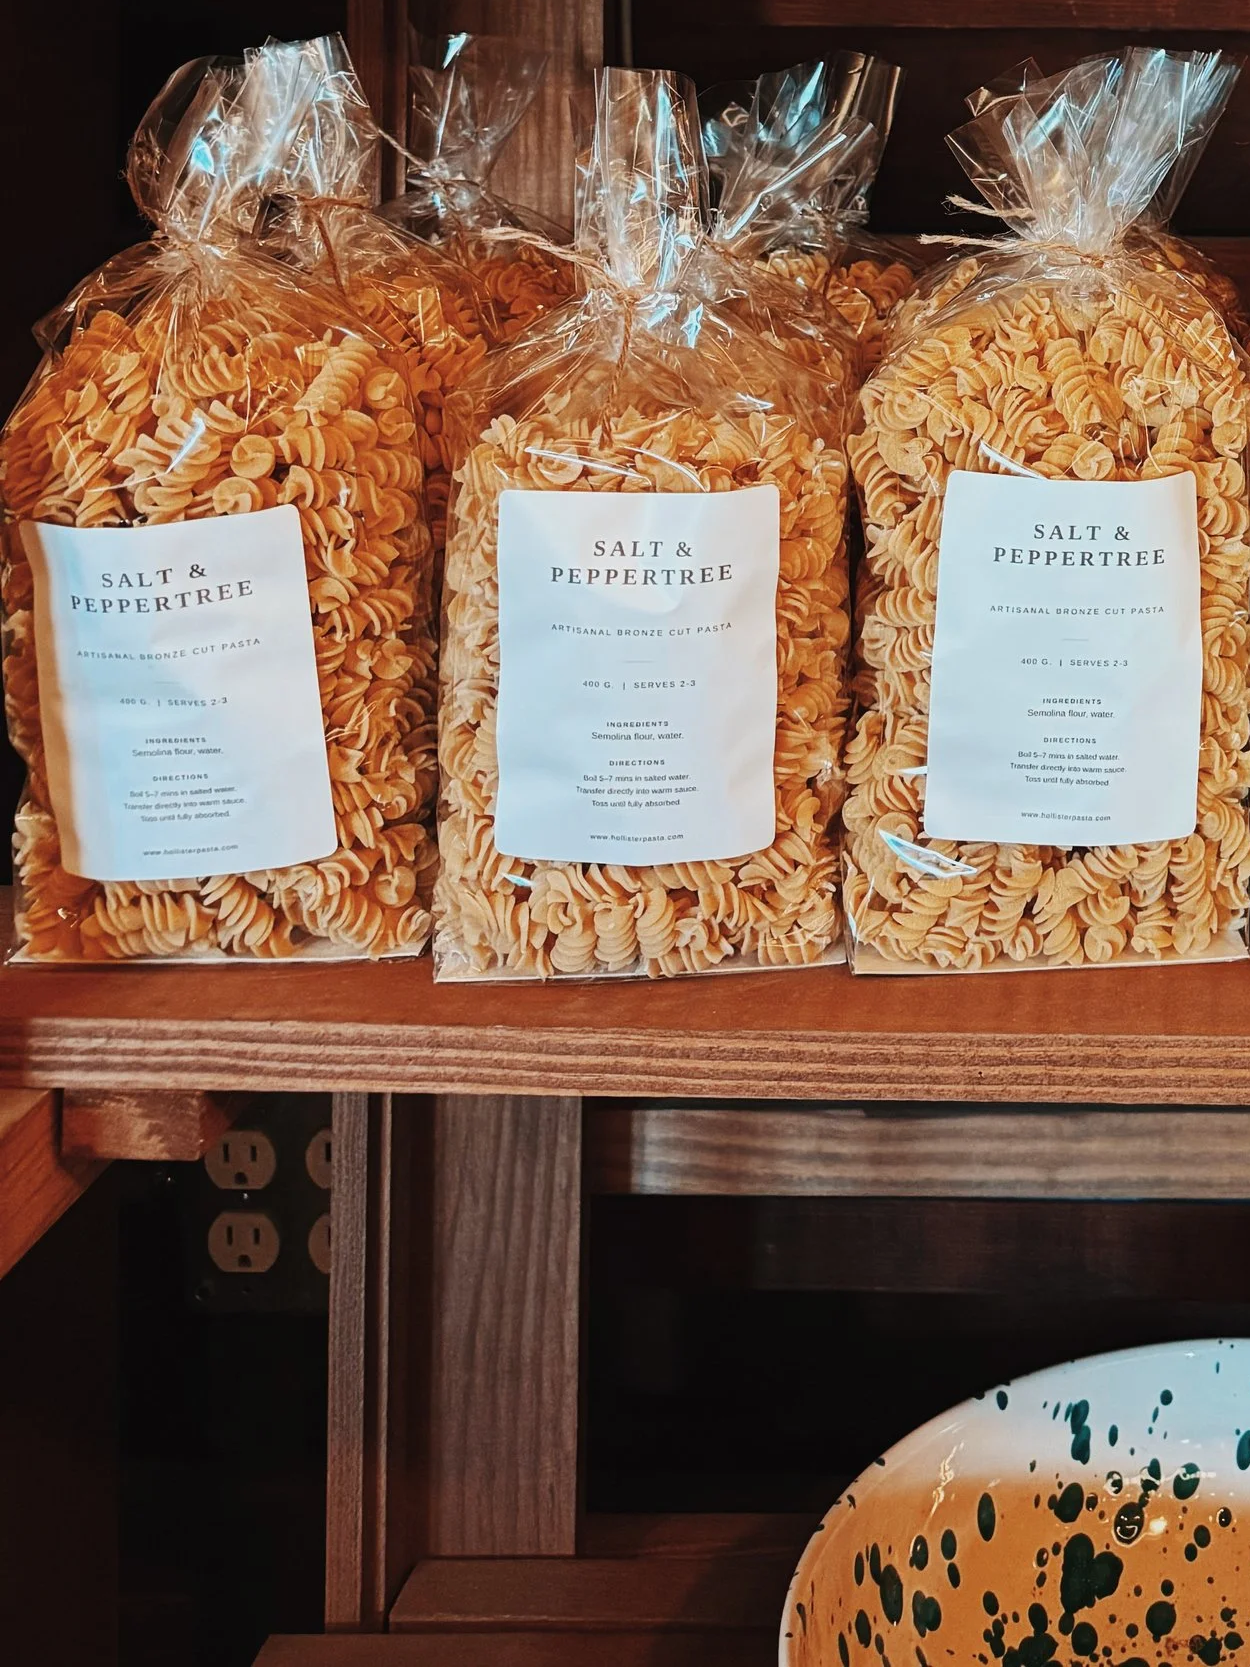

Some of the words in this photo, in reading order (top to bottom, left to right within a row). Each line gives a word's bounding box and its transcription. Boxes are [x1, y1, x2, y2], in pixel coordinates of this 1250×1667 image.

[1034, 524, 1101, 540] SALT
[1115, 526, 1129, 540] &
[594, 541, 663, 557] SALT
[676, 542, 692, 557] &
[994, 547, 1164, 566] PEPPERTREE
[102, 568, 172, 588] SALT
[190, 564, 206, 578] &
[551, 564, 732, 585] PEPPERTREE
[70, 580, 253, 613] PEPPERTREE
[990, 605, 1051, 615] ARTISANAL
[1055, 607, 1100, 616] BRONZE
[1104, 607, 1126, 615] CUT
[1130, 606, 1164, 615] PASTA
[552, 624, 611, 635] ARTISANAL
[616, 629, 663, 637] BRONZE
[668, 627, 691, 637] CUT
[698, 622, 731, 633] PASTA
[1069, 659, 1110, 667] SERVES
[1113, 659, 1128, 668] 2-3
[1041, 697, 1103, 705] INGREDIENTS
[1026, 708, 1067, 718] Semolina
[1067, 709, 1089, 719] flour,
[1090, 710, 1116, 719] water.
[1042, 737, 1097, 745] DIRECTIONS
[1020, 811, 1111, 822] www.hollisterpasta.com
